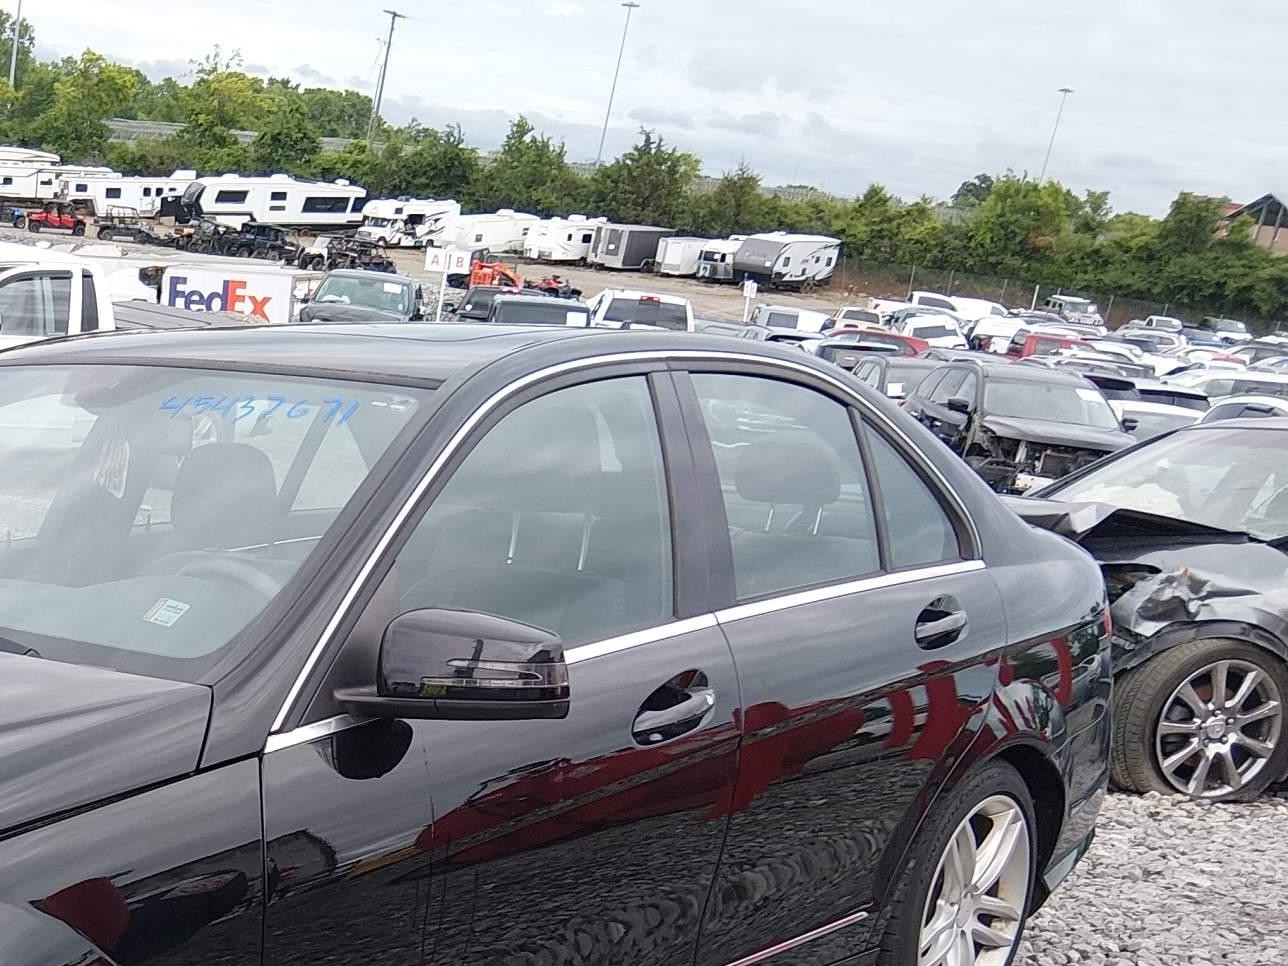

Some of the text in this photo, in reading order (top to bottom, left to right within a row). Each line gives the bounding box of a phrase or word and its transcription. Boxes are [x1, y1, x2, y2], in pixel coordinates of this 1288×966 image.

[430, 254, 440, 266] A
[455, 256, 464, 268] B
[168, 276, 272, 323] FedEx
[158, 392, 361, 428] 45437671
